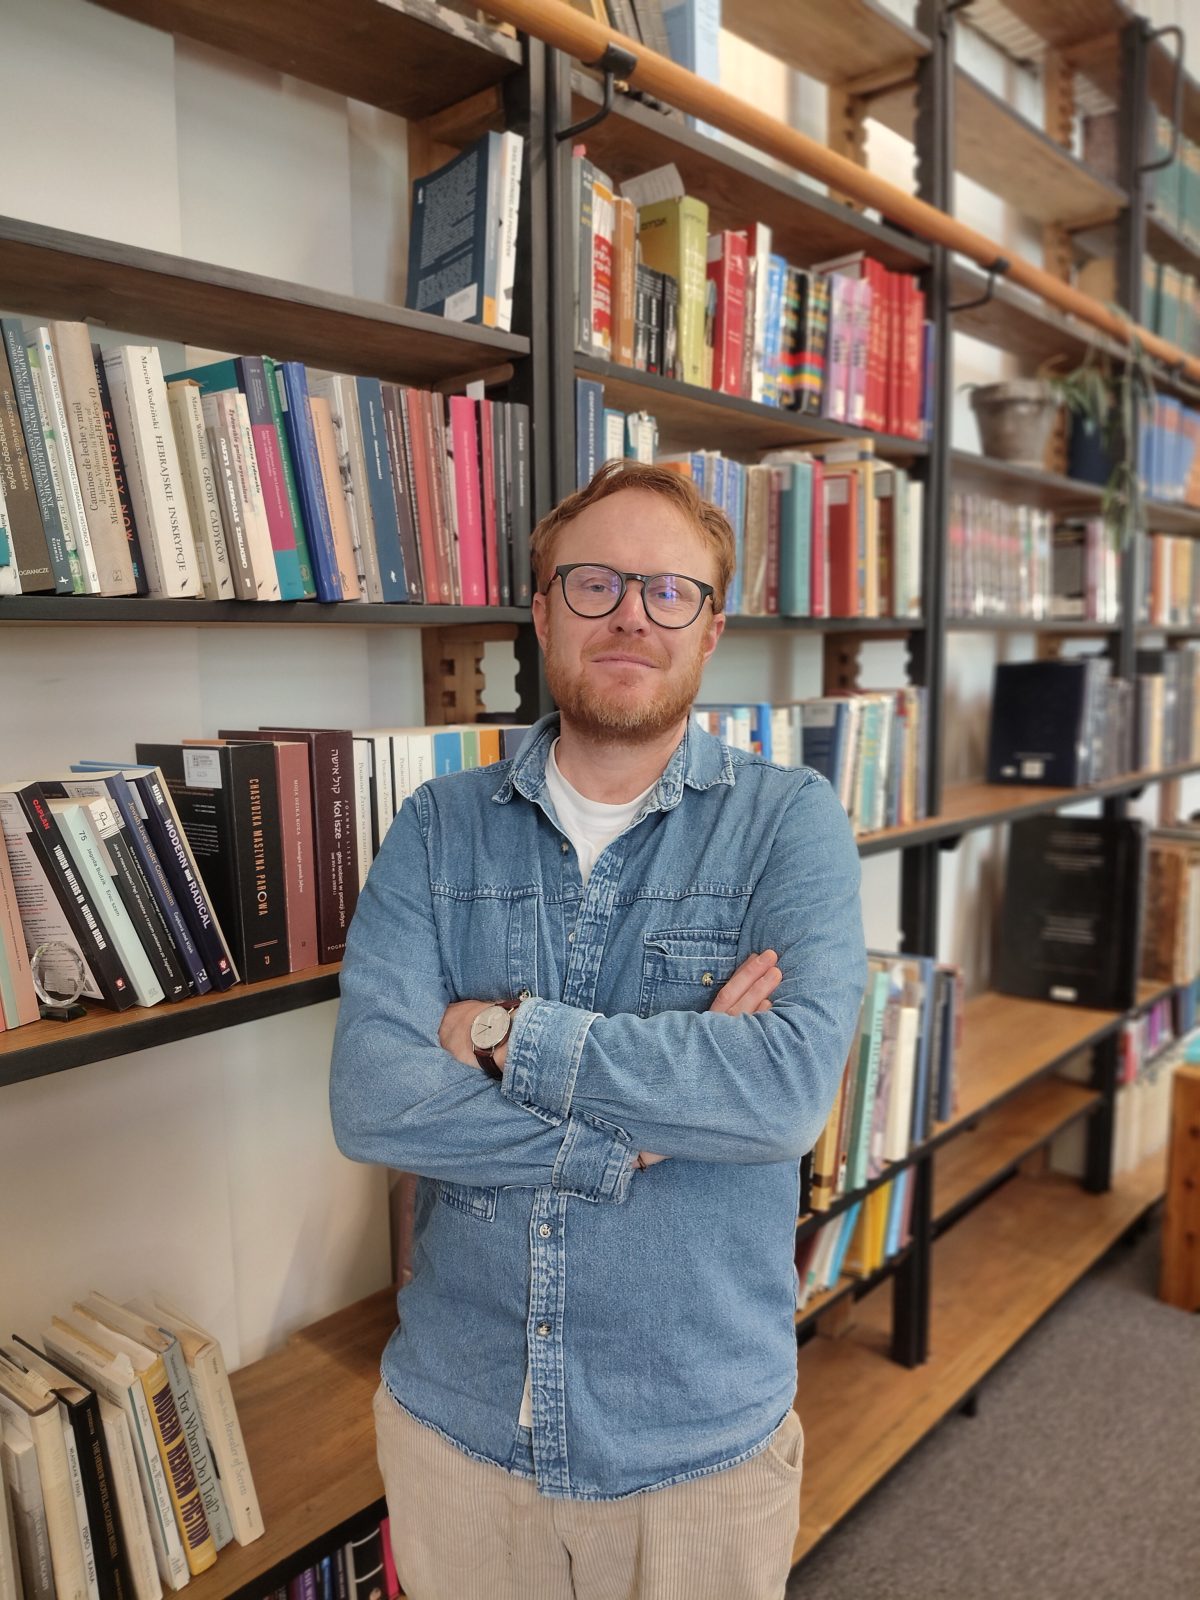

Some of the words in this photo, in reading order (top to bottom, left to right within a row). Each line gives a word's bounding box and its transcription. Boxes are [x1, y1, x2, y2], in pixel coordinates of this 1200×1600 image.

[7, 330, 18, 365] SOLOMON
[13, 365, 23, 389] DUBNO
[15, 344, 29, 382] SHAPING
[23, 383, 32, 402] THE
[27, 402, 39, 434] JEWISH
[72, 401, 83, 422] miel
[84, 406, 91, 415] of
[191, 395, 200, 421] Marcin
[25, 423, 32, 432] AN
[86, 417, 95, 439] Honor
[228, 408, 239, 442] Żydowskie
[2, 389, 15, 426] AGNIESZKA
[11, 428, 30, 490] AUGUST-ZARĘBSKA
[27, 432, 38, 462] EASTERN
[77, 432, 88, 456] leche
[90, 399, 112, 488] Studemund-Halévy
[196, 423, 207, 459] Wodziński
[219, 437, 229, 465] LESKU
[233, 443, 242, 463] gminy
[34, 435, 53, 508] ENLIGHTENMENT
[62, 431, 75, 480] APROXIMACIONES
[72, 481, 82, 511] LITERARIAS
[81, 458, 91, 470] de
[91, 449, 102, 476] Volume
[139, 354, 151, 385] Marcin
[145, 387, 159, 430] Wodziński
[154, 434, 174, 502] HEBRAJSKIE
[166, 505, 186, 572] INSKRYPCJE
[225, 467, 231, 476] W
[245, 426, 255, 460] Cmentarze
[251, 461, 261, 493] żydowskie
[4, 462, 17, 490] języka
[33, 462, 45, 497] EUROPEAN
[103, 410, 124, 494] ETERNITY
[121, 504, 133, 542] NOW
[201, 466, 214, 504] GROBY
[238, 464, 249, 503] wyznaniowe
[84, 471, 98, 511] Caminos
[95, 477, 106, 504] Jubilee
[40, 497, 49, 521] MASKIL
[105, 489, 118, 524] Michael
[209, 509, 225, 564] CADYKÓW
[235, 526, 248, 568] CMENTARZ
[330, 748, 339, 774] אישה
[151, 783, 164, 805] KIJEK
[331, 776, 342, 793] קול
[32, 798, 50, 830] CAPLAN
[249, 778, 261, 826] CHASYDZKA
[333, 800, 342, 817] Kol
[163, 818, 188, 868] MODERN
[334, 819, 343, 839] isze
[52, 844, 69, 869] YIDDISH
[86, 847, 98, 867] Jagoda
[252, 829, 265, 871] MASZYNA
[63, 867, 81, 896] WRITERS
[127, 801, 142, 825] Jewish
[137, 824, 149, 843] Lives
[145, 843, 158, 864] under
[154, 864, 175, 906] Communism
[185, 940, 194, 954] Kijek
[183, 868, 193, 882] and
[75, 894, 85, 903] IN
[187, 880, 212, 928] RADICAL
[255, 874, 268, 915] PAROWA
[79, 903, 97, 930] WEIMAR
[91, 928, 106, 950] BERLIN
[152, 1383, 184, 1446] MODERN
[176, 1391, 192, 1413] For
[91, 1439, 100, 1454] THE
[182, 1412, 205, 1457] Whom
[224, 1420, 241, 1456] Revealer
[94, 1453, 104, 1479] HEBREW
[167, 1441, 201, 1499] HEBREW
[193, 1456, 210, 1478] Do
[231, 1457, 242, 1466] of
[98, 1478, 108, 1502] NOVEL
[199, 1478, 212, 1486] I
[234, 1466, 249, 1496] Secrets
[102, 1501, 109, 1510] IN
[201, 1488, 219, 1514] Toil?
[180, 1492, 210, 1550] FICTION
[81, 1526, 90, 1549] PISMO
[86, 1560, 95, 1584] RANA
